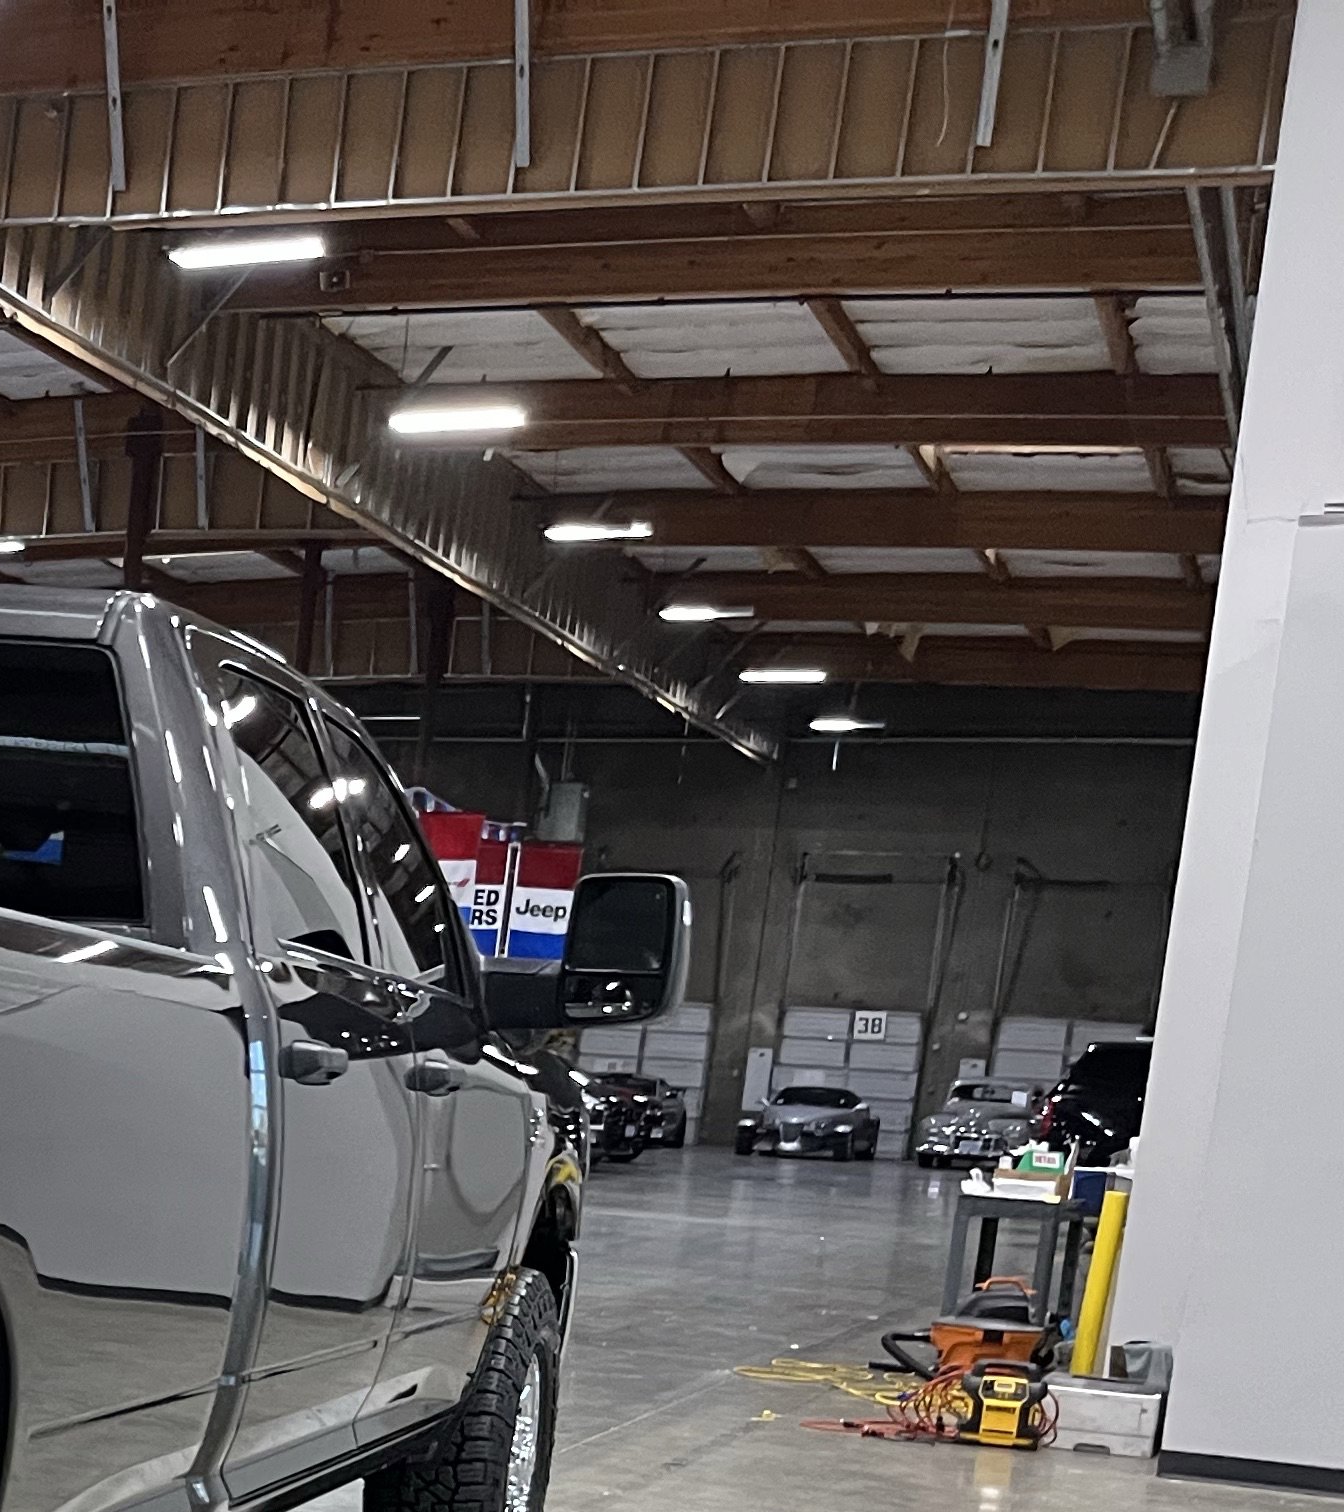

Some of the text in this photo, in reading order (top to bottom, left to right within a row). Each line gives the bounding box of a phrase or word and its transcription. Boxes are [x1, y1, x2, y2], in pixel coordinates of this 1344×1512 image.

[473, 889, 500, 906] ED
[471, 909, 497, 926] RS
[515, 898, 567, 922] Jeep
[857, 1017, 883, 1034] 38
